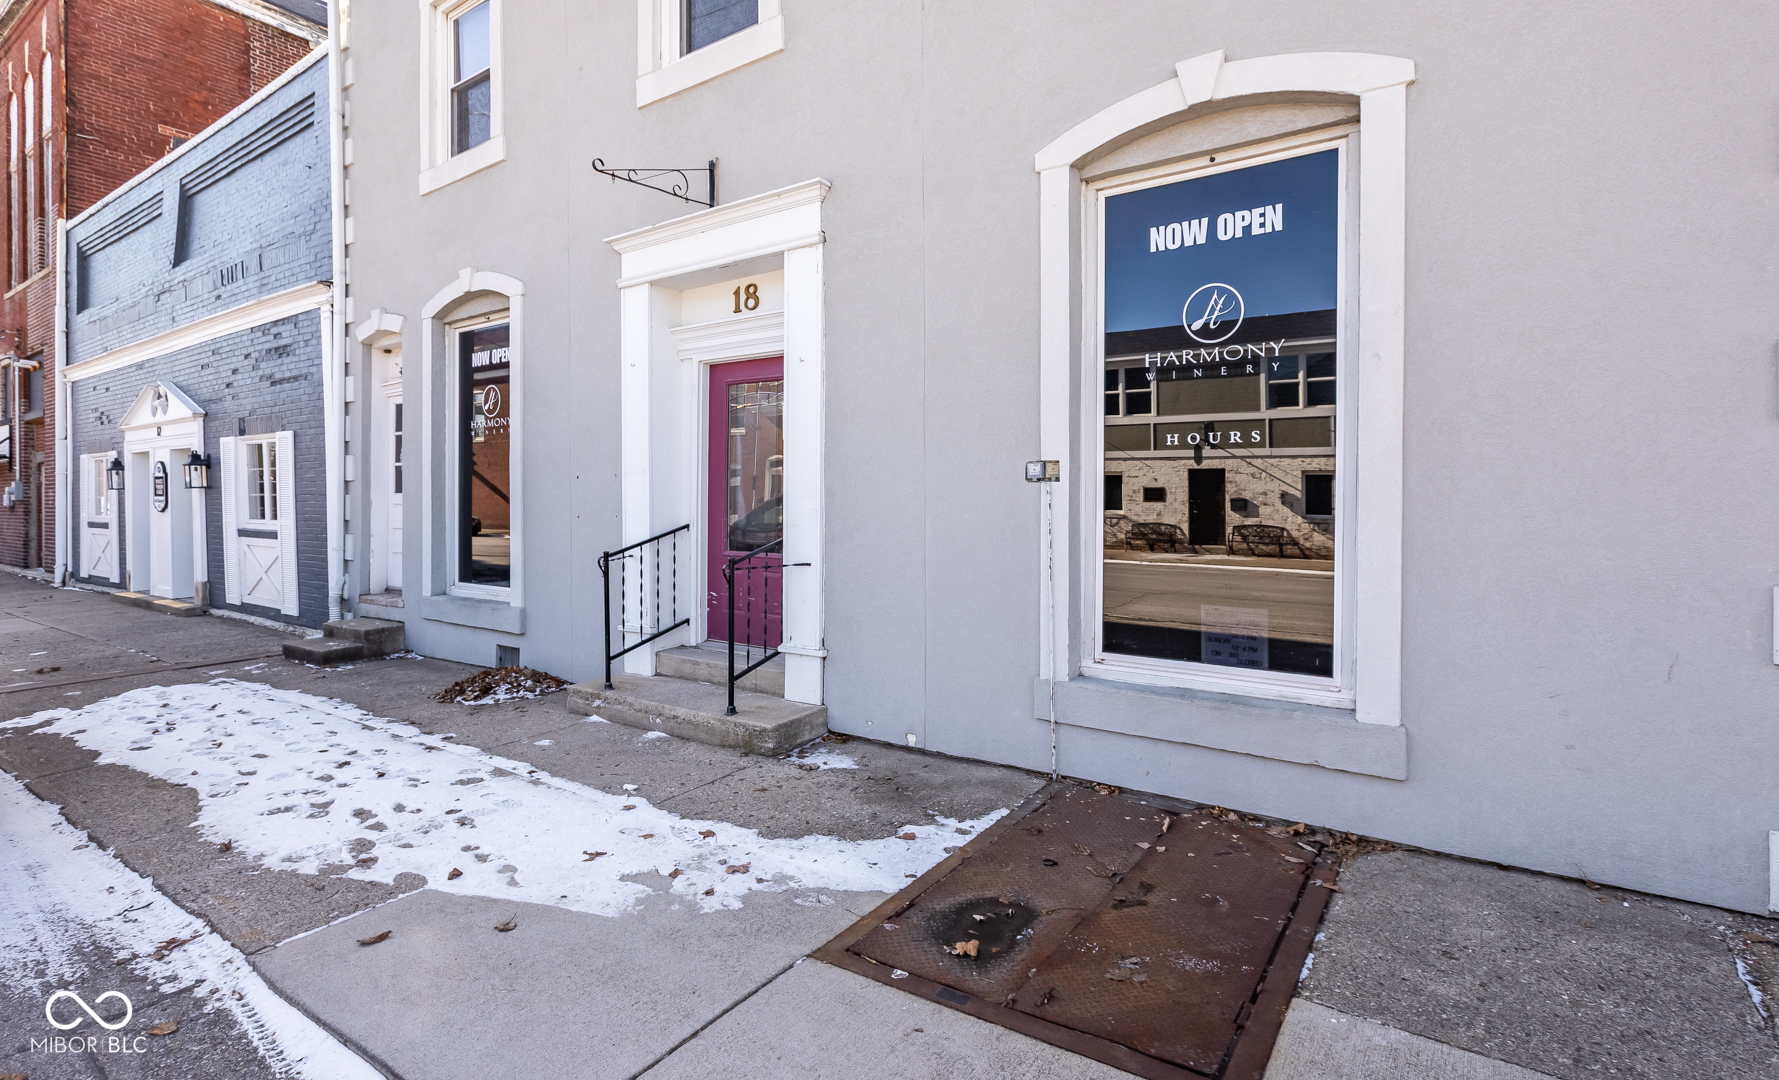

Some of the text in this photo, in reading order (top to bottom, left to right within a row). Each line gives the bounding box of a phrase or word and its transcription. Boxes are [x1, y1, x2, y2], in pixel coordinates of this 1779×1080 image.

[1149, 203, 1283, 253] NOW OPEN
[732, 283, 760, 314] 18
[472, 347, 510, 367] NOW OPEN
[1144, 338, 1286, 368] HARMONY
[1145, 361, 1281, 382] WINERY
[1165, 430, 1262, 446] HOURS
[1236, 659, 1262, 667] CLOSED
